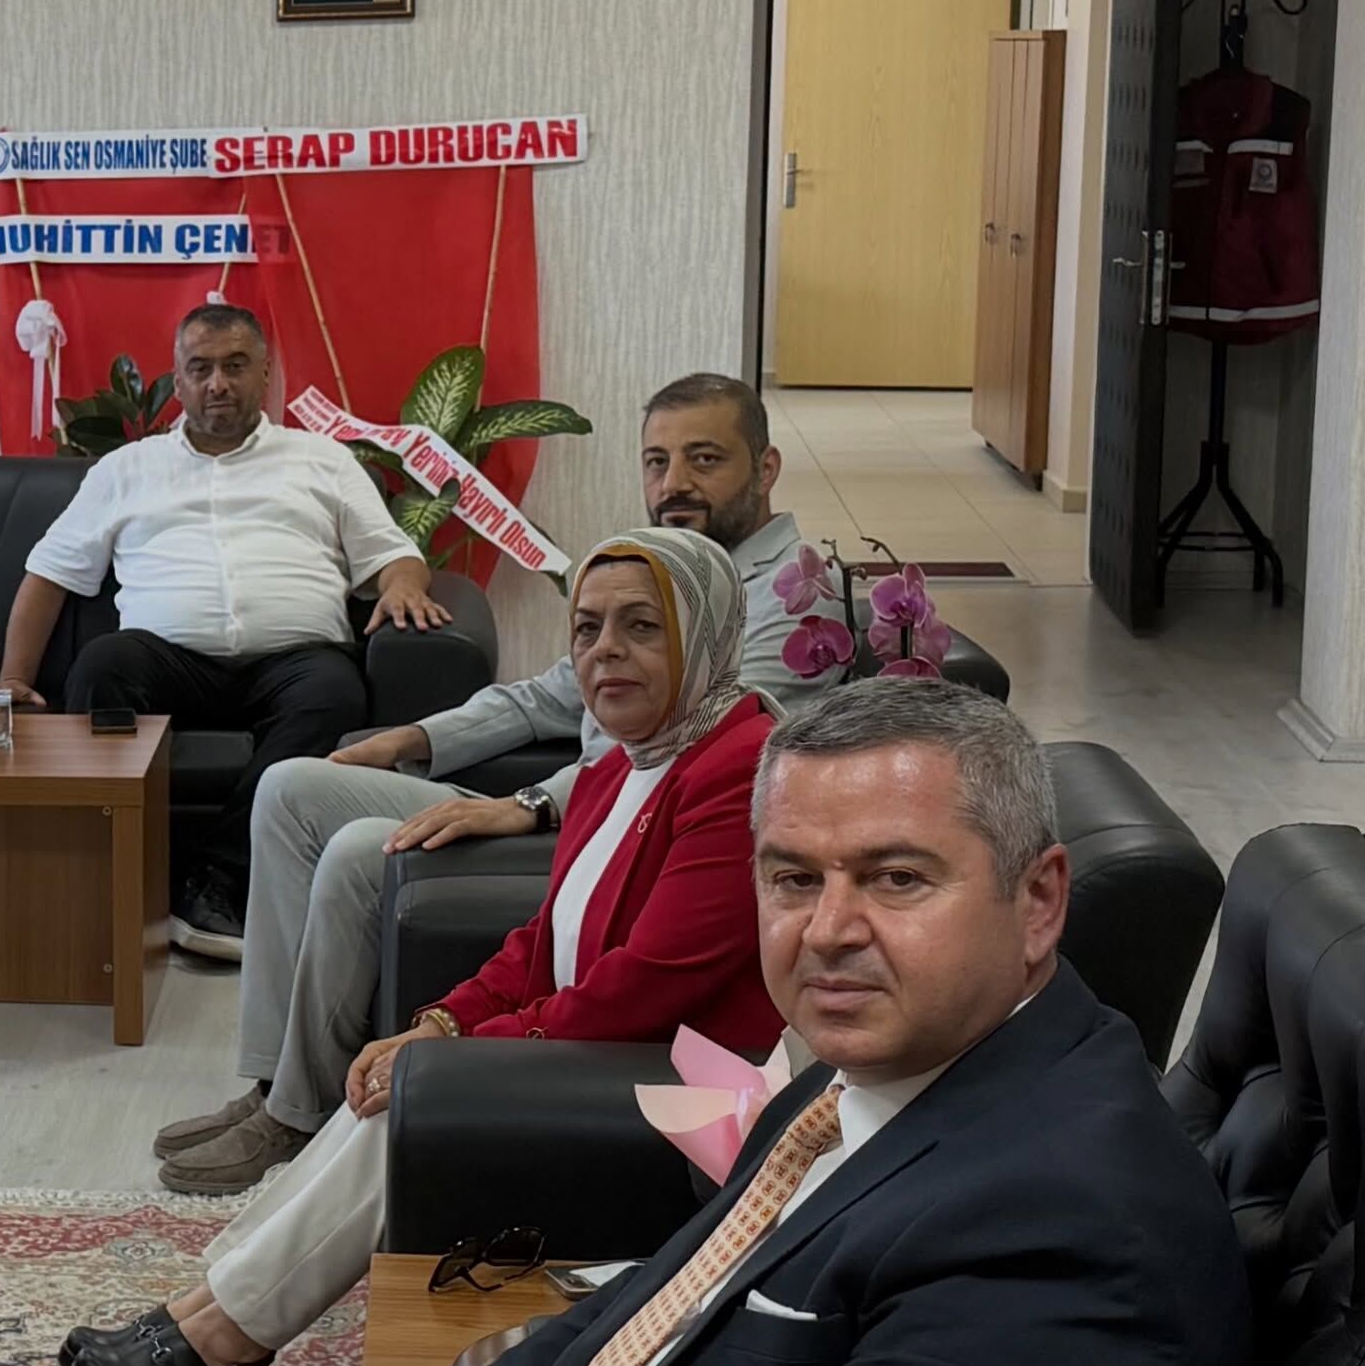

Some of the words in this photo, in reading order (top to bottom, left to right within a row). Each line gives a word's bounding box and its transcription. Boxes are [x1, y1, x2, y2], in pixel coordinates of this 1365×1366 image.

[11, 136, 61, 171] SAĞLIK
[64, 140, 90, 170] SEN
[94, 134, 167, 170] OSMANİYE
[214, 132, 354, 174] SERAP
[369, 119, 578, 166] DURUCAN
[498, 518, 547, 570] Olsun
